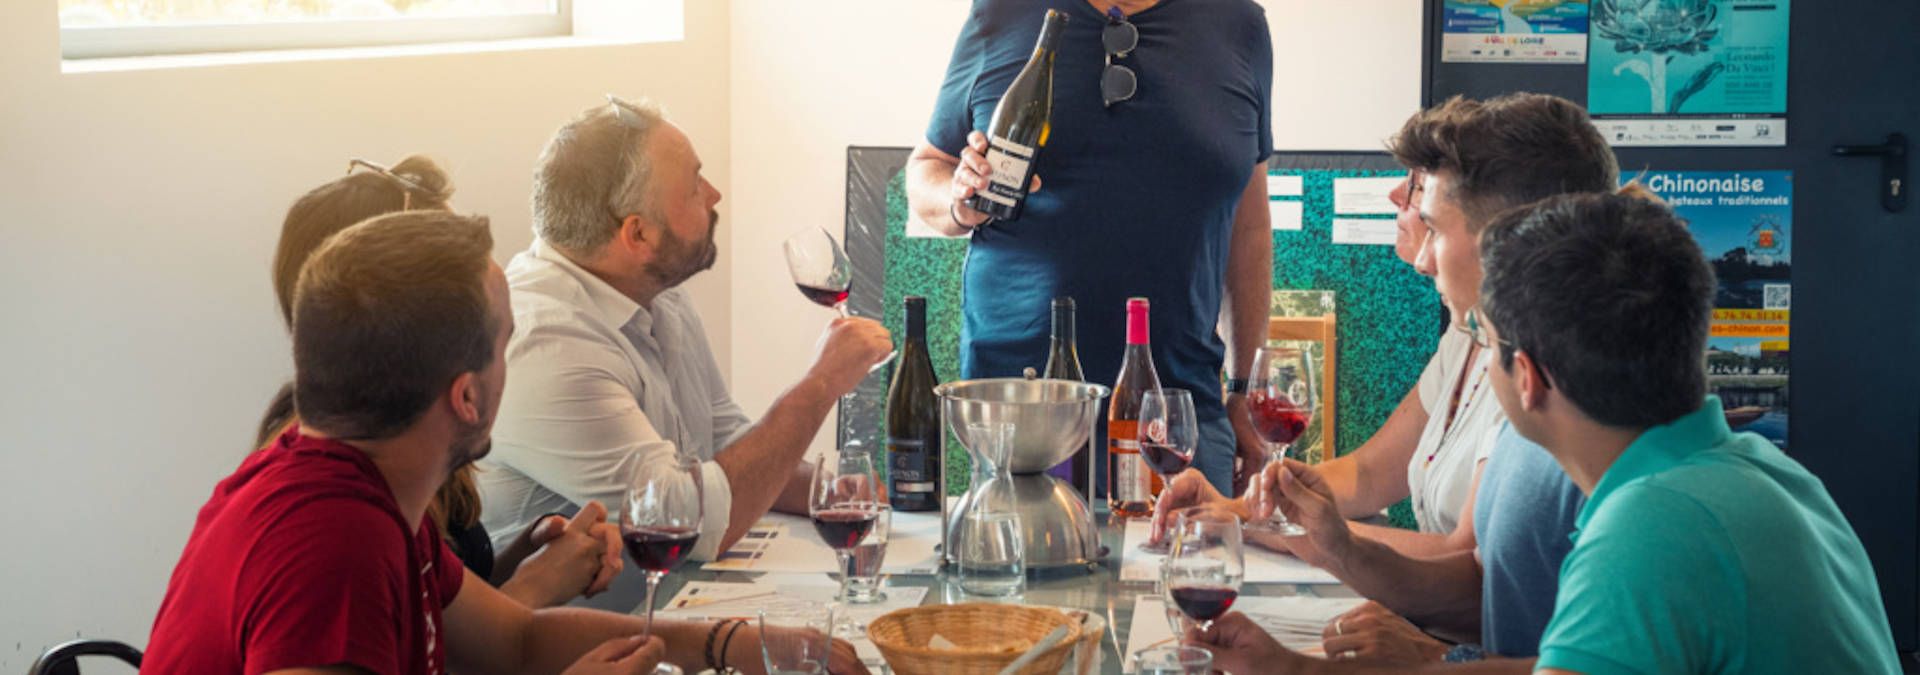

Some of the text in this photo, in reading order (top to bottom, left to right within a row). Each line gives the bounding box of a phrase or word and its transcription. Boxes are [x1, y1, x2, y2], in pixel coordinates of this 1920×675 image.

[1726, 52, 1776, 62] Leonardo
[1726, 63, 1740, 73] Da
[1648, 173, 1764, 193] Chinonaise
[1668, 196, 1713, 206] bateaux
[1718, 195, 1789, 206] traditionnels
